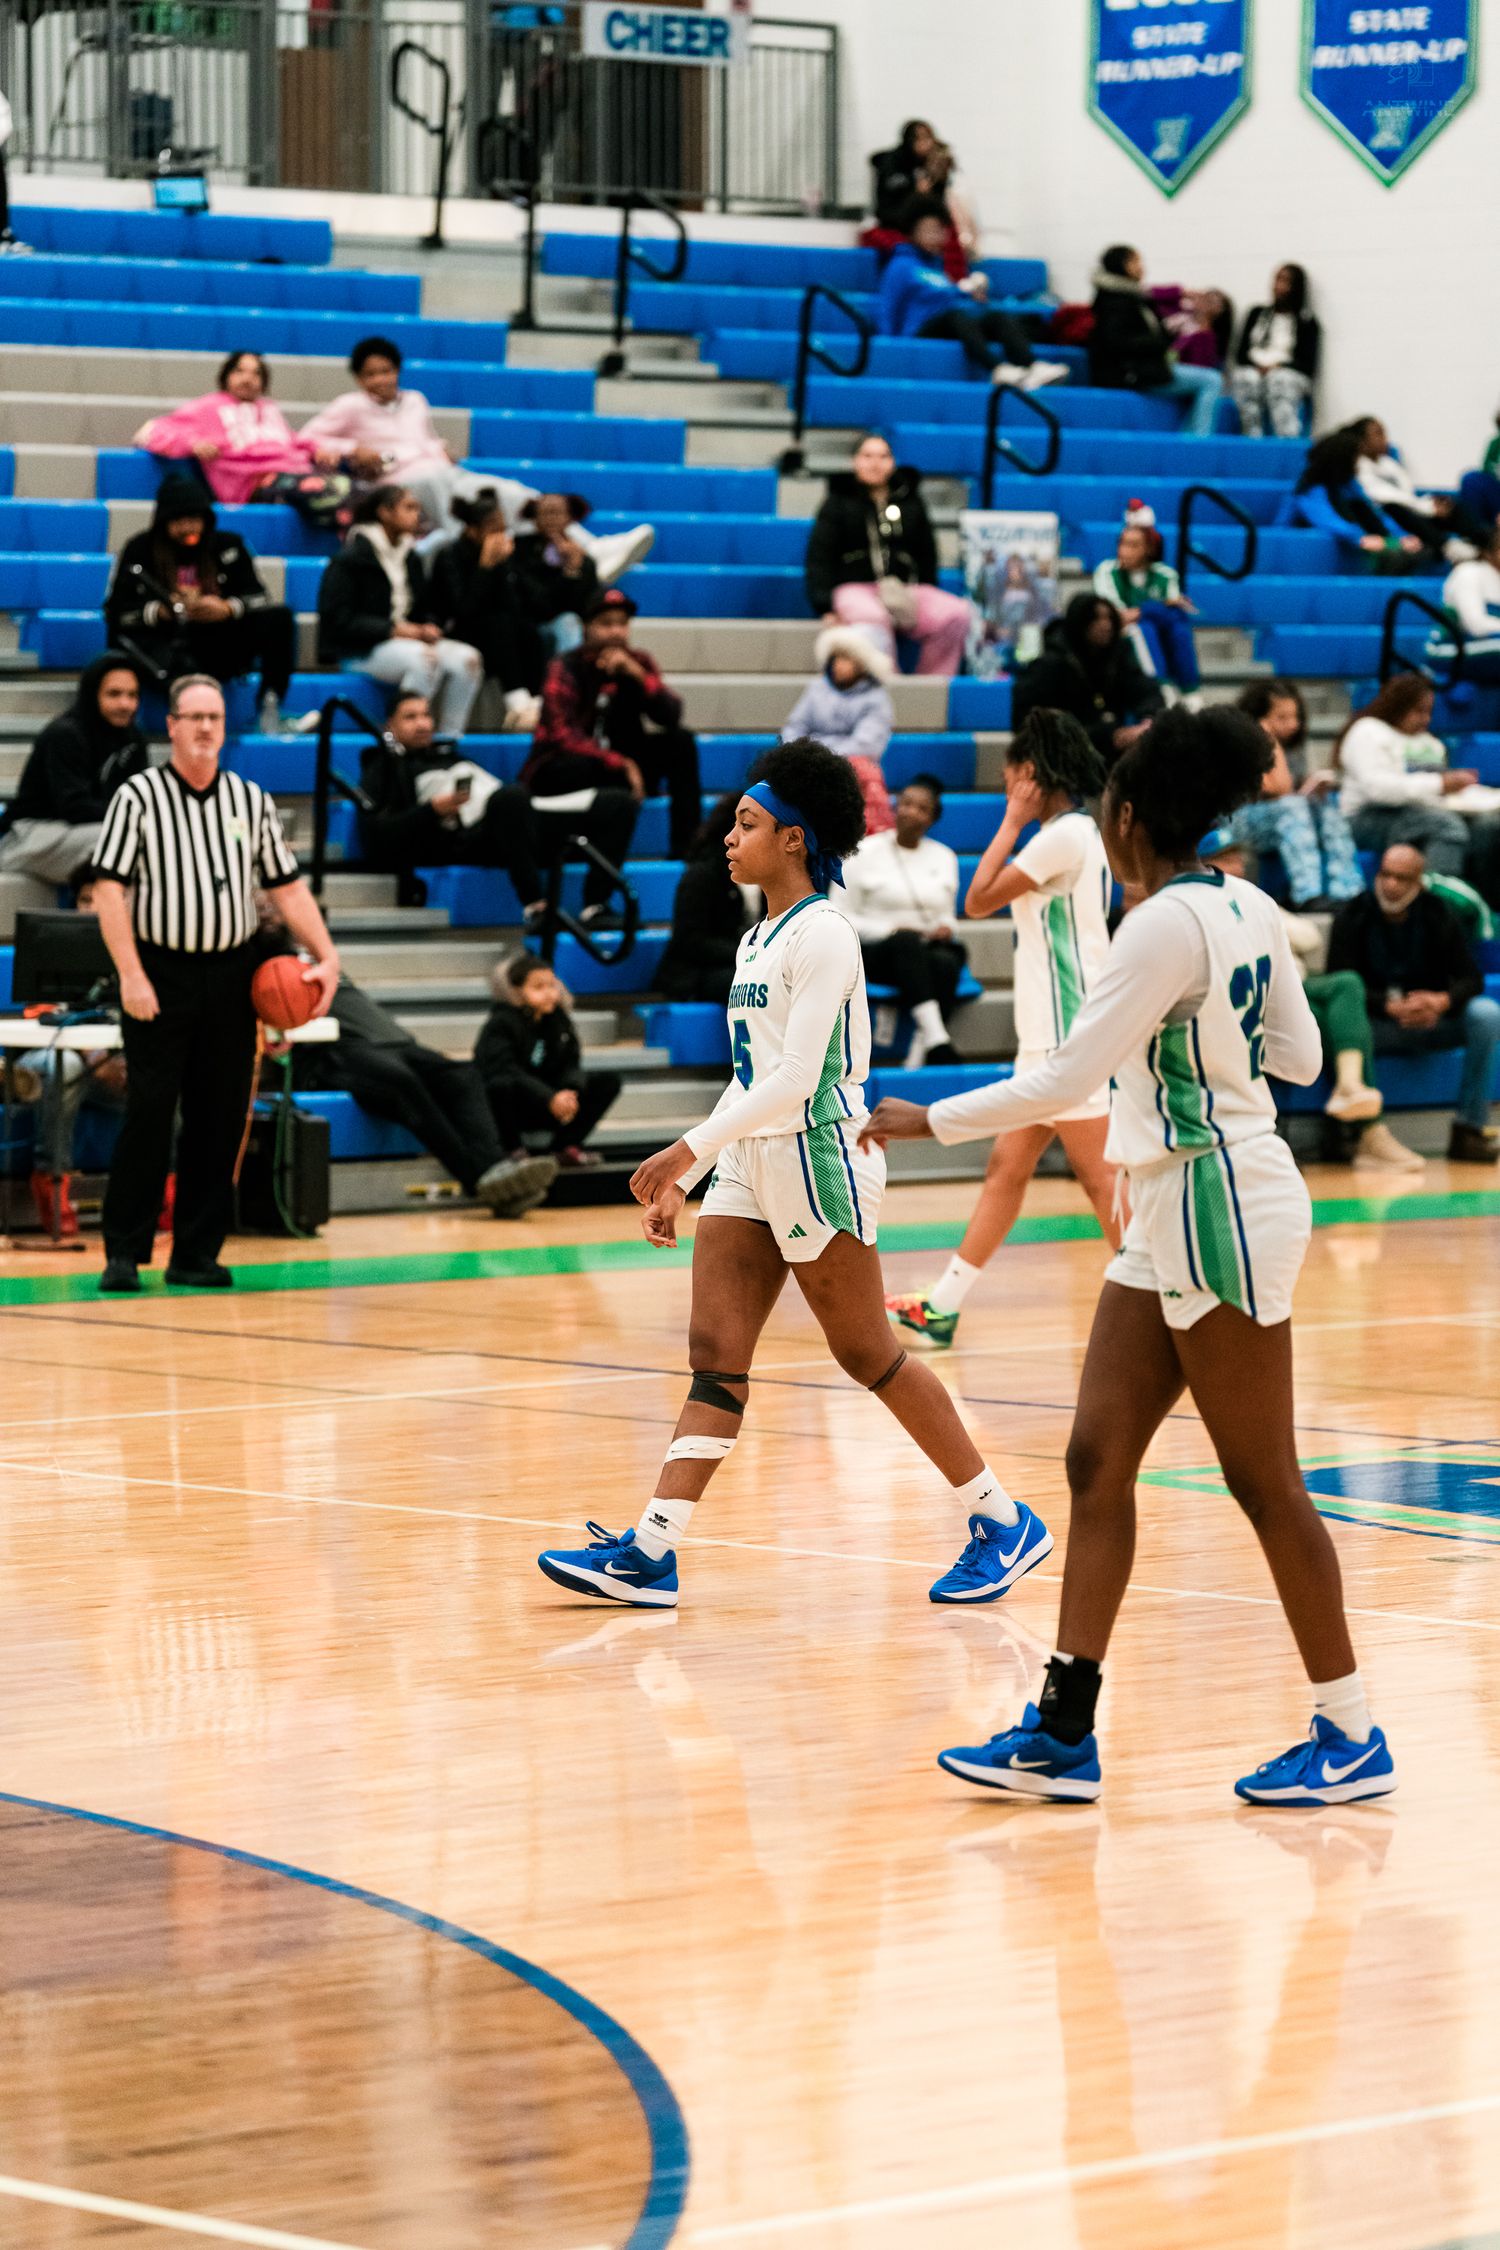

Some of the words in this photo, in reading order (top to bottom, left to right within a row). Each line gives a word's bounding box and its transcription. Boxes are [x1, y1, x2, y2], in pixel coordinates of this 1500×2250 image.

[1349, 6, 1432, 34] STATE
[605, 11, 730, 59] CHEER
[1132, 21, 1208, 49] STATE
[728, 982, 769, 1009] RRIORS
